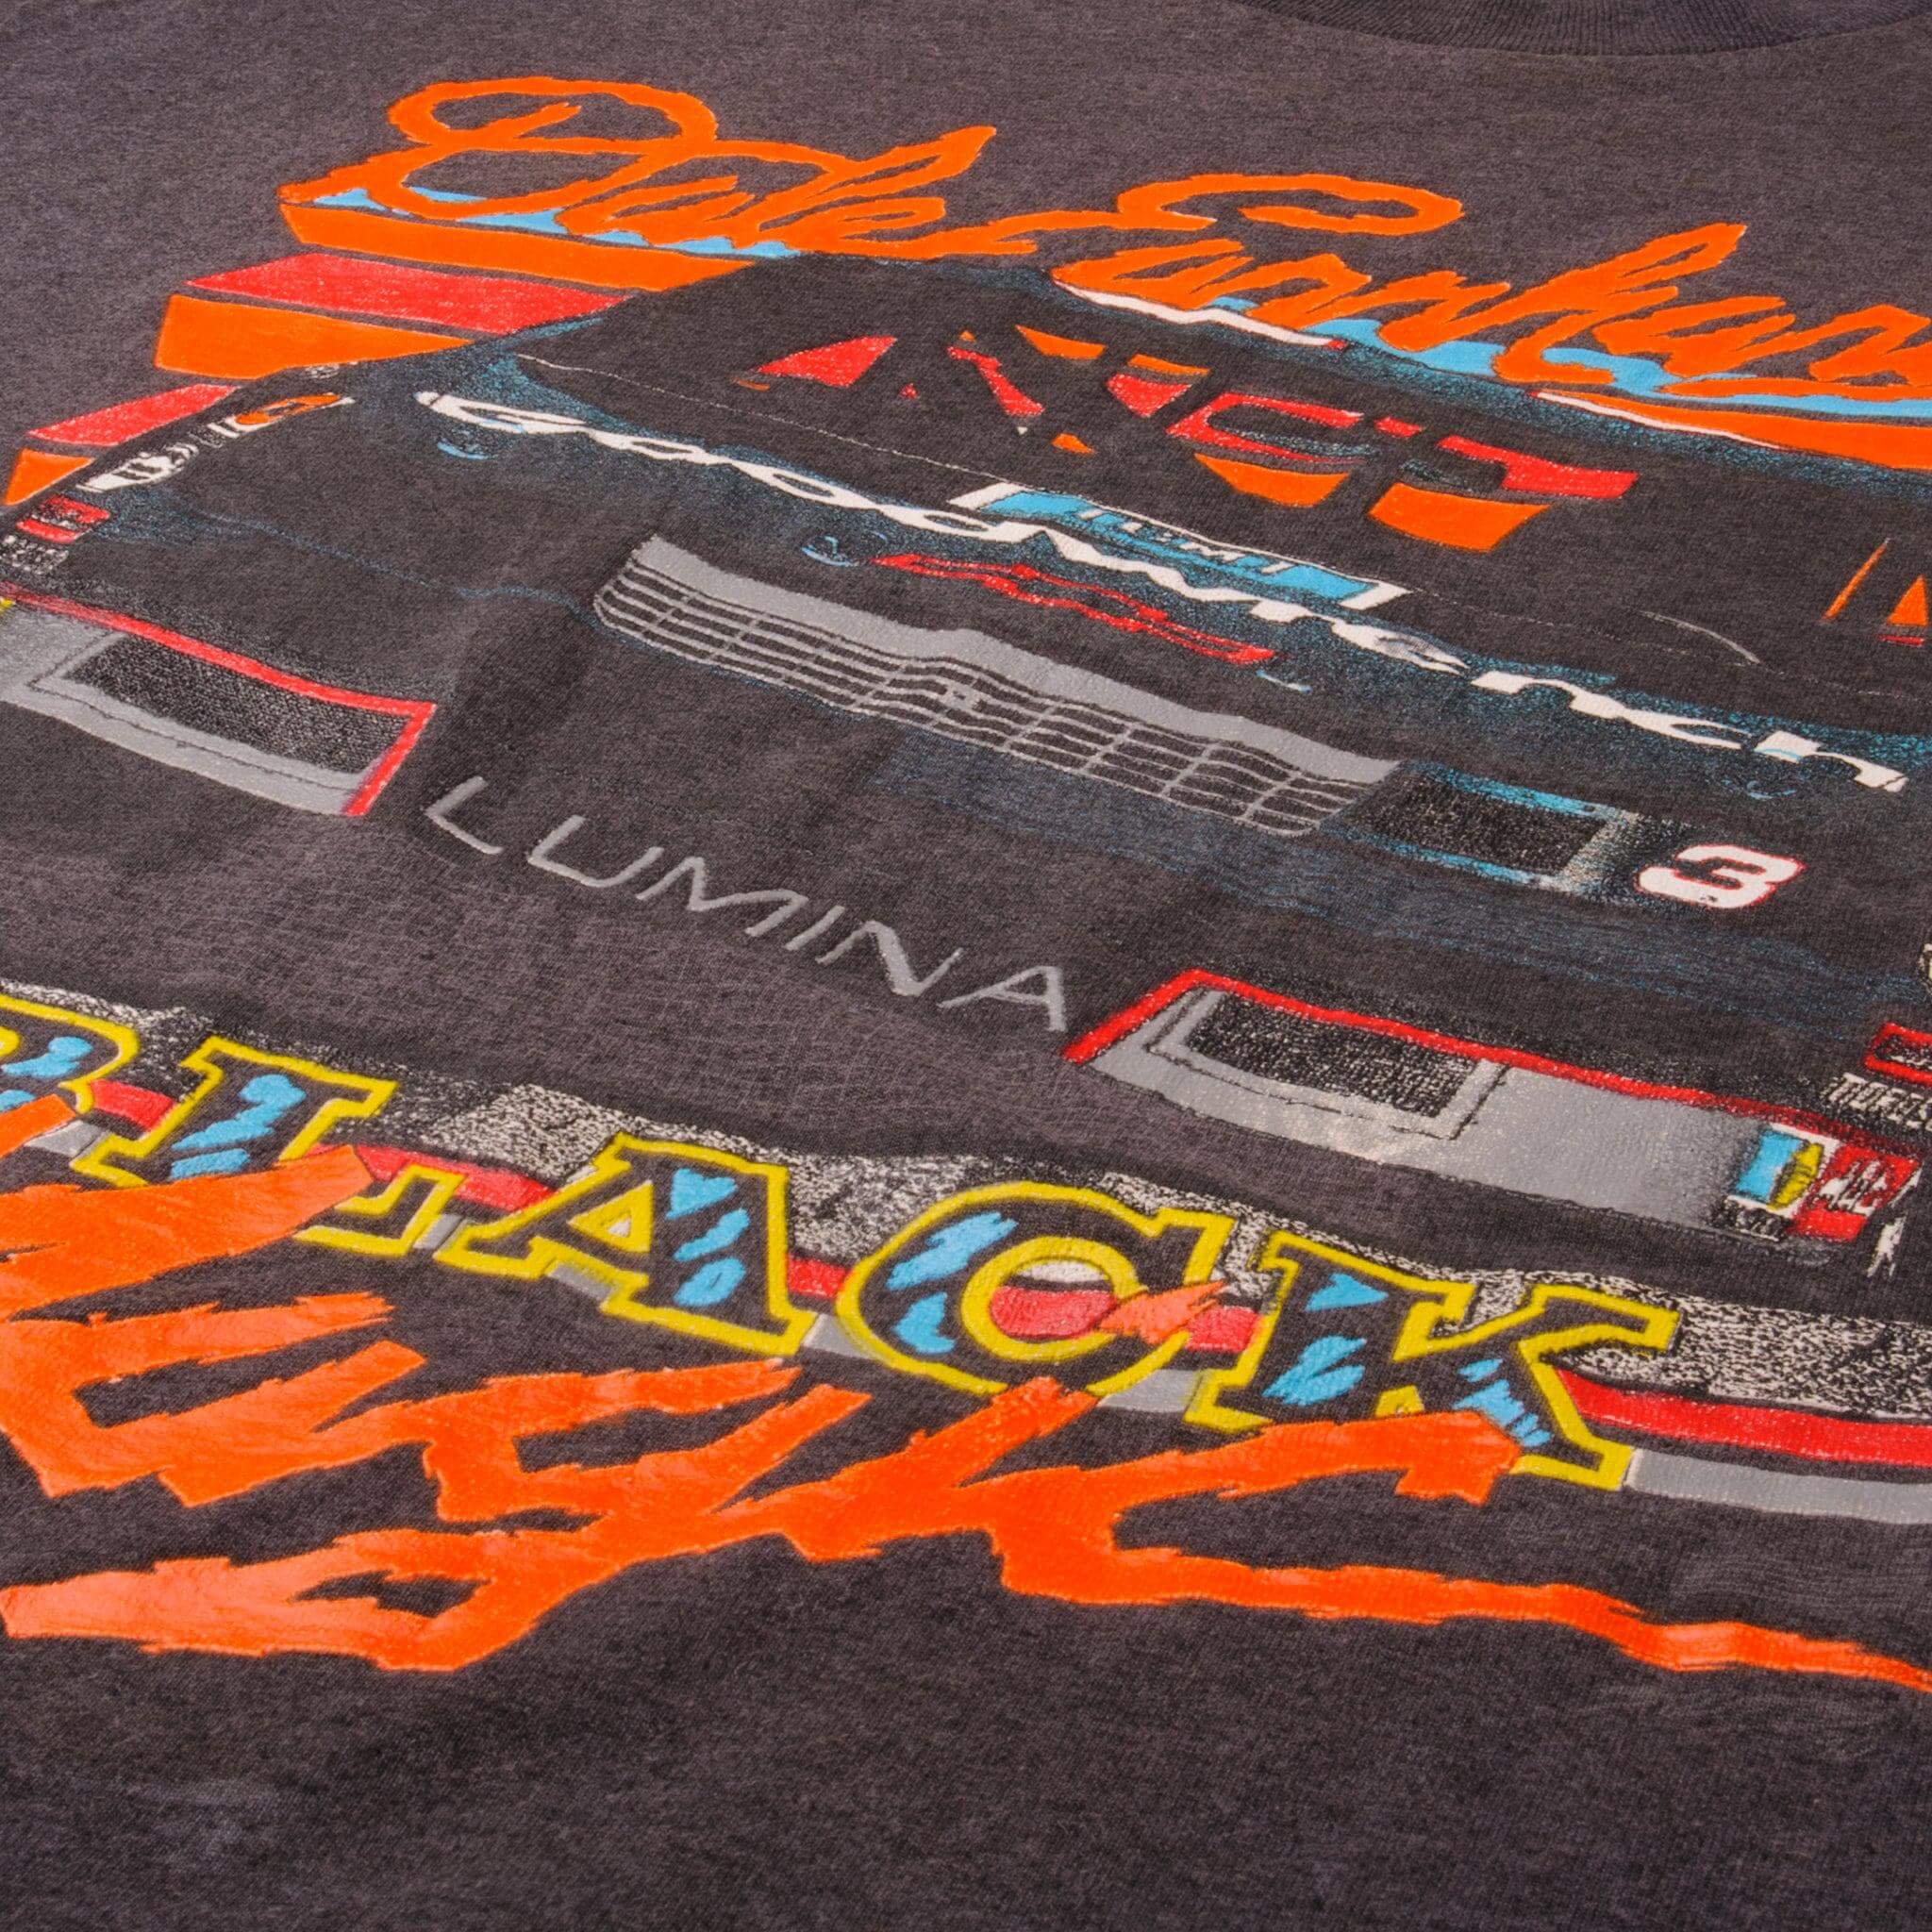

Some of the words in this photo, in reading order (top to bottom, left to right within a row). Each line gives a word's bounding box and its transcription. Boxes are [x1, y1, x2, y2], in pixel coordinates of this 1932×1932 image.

[277, 75, 1038, 260] Dale
[425, 775, 1068, 1034] LUMINA
[1636, 844, 1806, 909] 3
